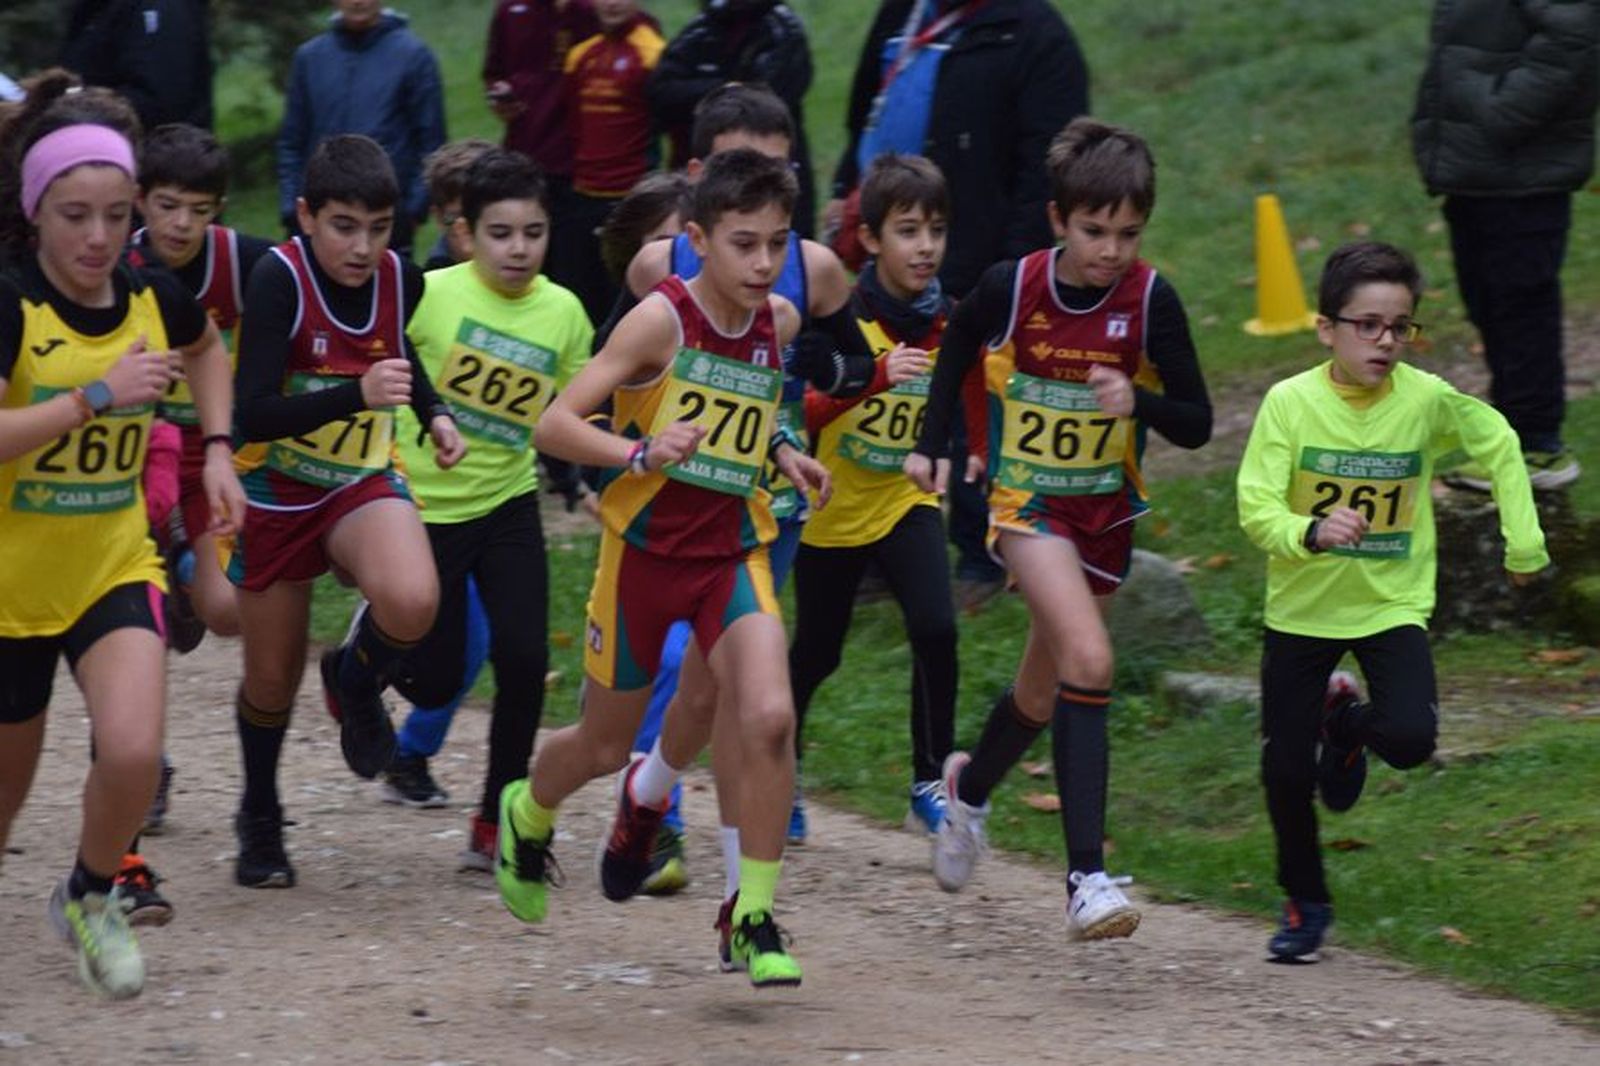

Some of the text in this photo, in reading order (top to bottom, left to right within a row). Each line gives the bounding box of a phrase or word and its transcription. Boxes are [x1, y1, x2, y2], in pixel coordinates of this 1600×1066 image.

[448, 354, 540, 416] 262
[34, 423, 142, 474] 260
[679, 391, 762, 455] 270
[1017, 410, 1119, 461] 267
[1310, 481, 1402, 527] 261
